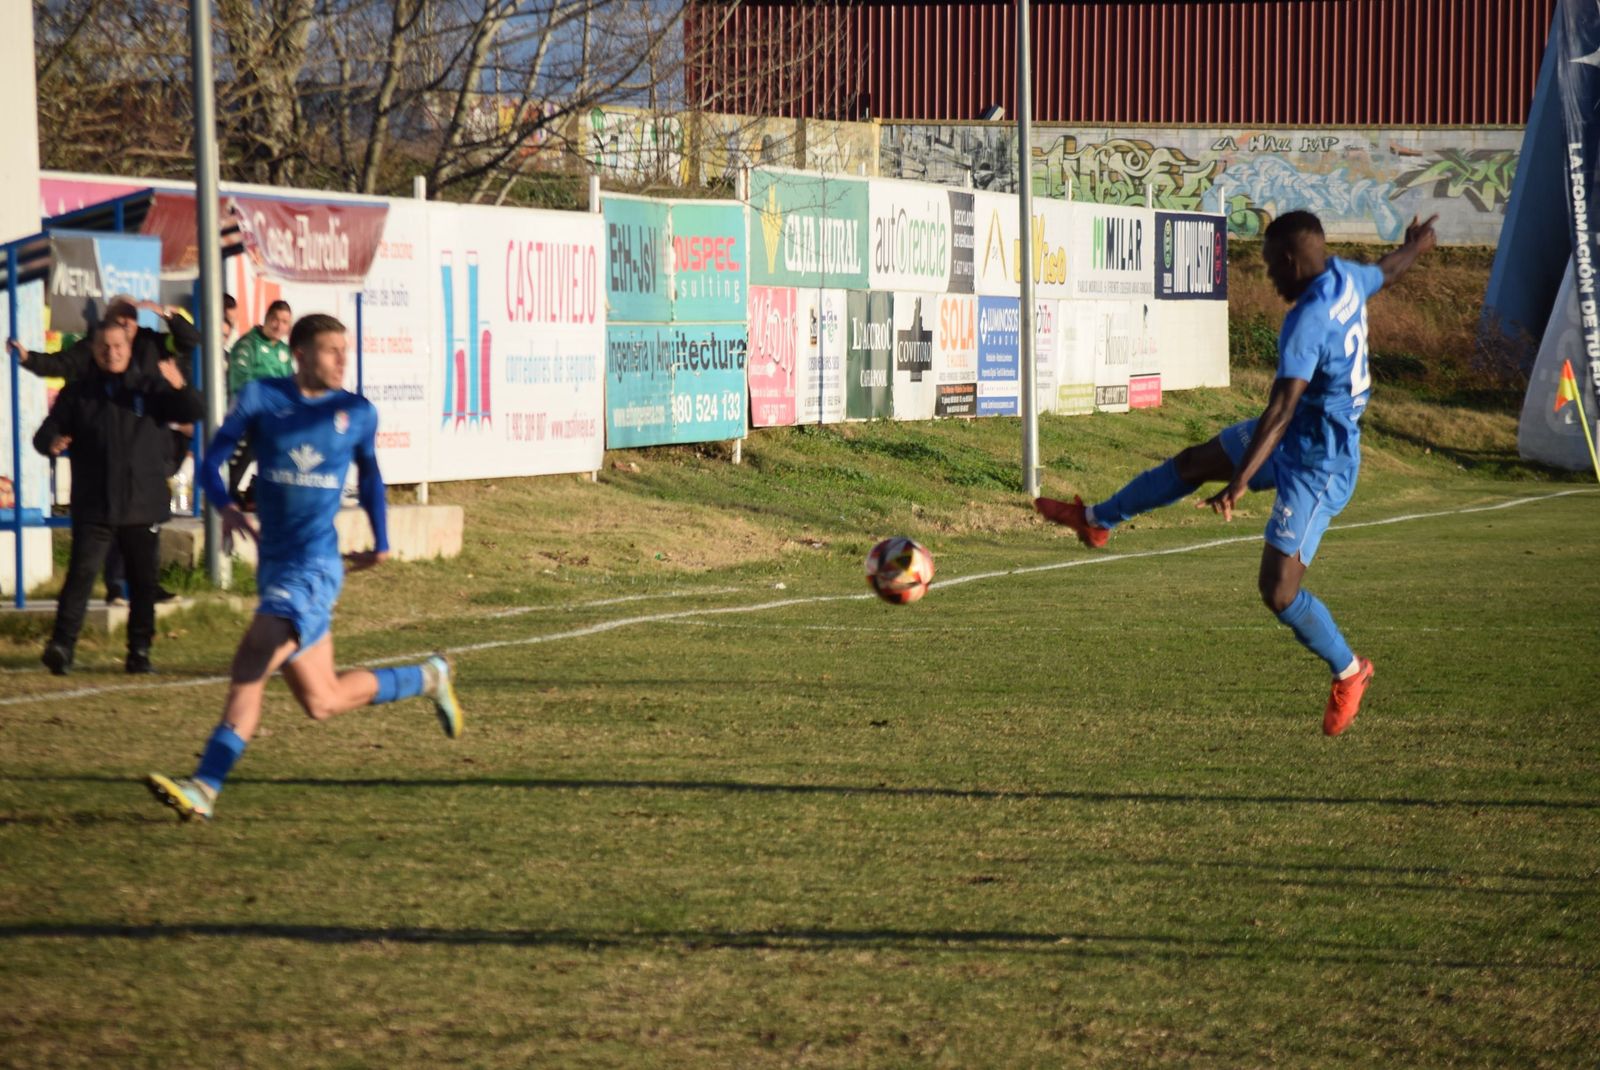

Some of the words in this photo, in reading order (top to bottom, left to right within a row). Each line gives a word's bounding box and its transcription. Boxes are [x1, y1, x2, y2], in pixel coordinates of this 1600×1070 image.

[1568, 142, 1583, 170] LA
[784, 214, 817, 277] CAJA
[819, 216, 861, 276] RURAL
[1106, 217, 1142, 272] MILAR
[1571, 173, 1596, 294] FORMACIÓN
[505, 239, 596, 324] CASTILVIEJO
[940, 298, 975, 351] SOLA
[1581, 299, 1598, 328] DE
[608, 331, 649, 383] Ingeniería
[656, 331, 747, 376] Arquitectura
[898, 341, 932, 363] COVITORO
[1584, 330, 1600, 357] TU
[695, 393, 718, 423] 524
[722, 391, 741, 421] 133
